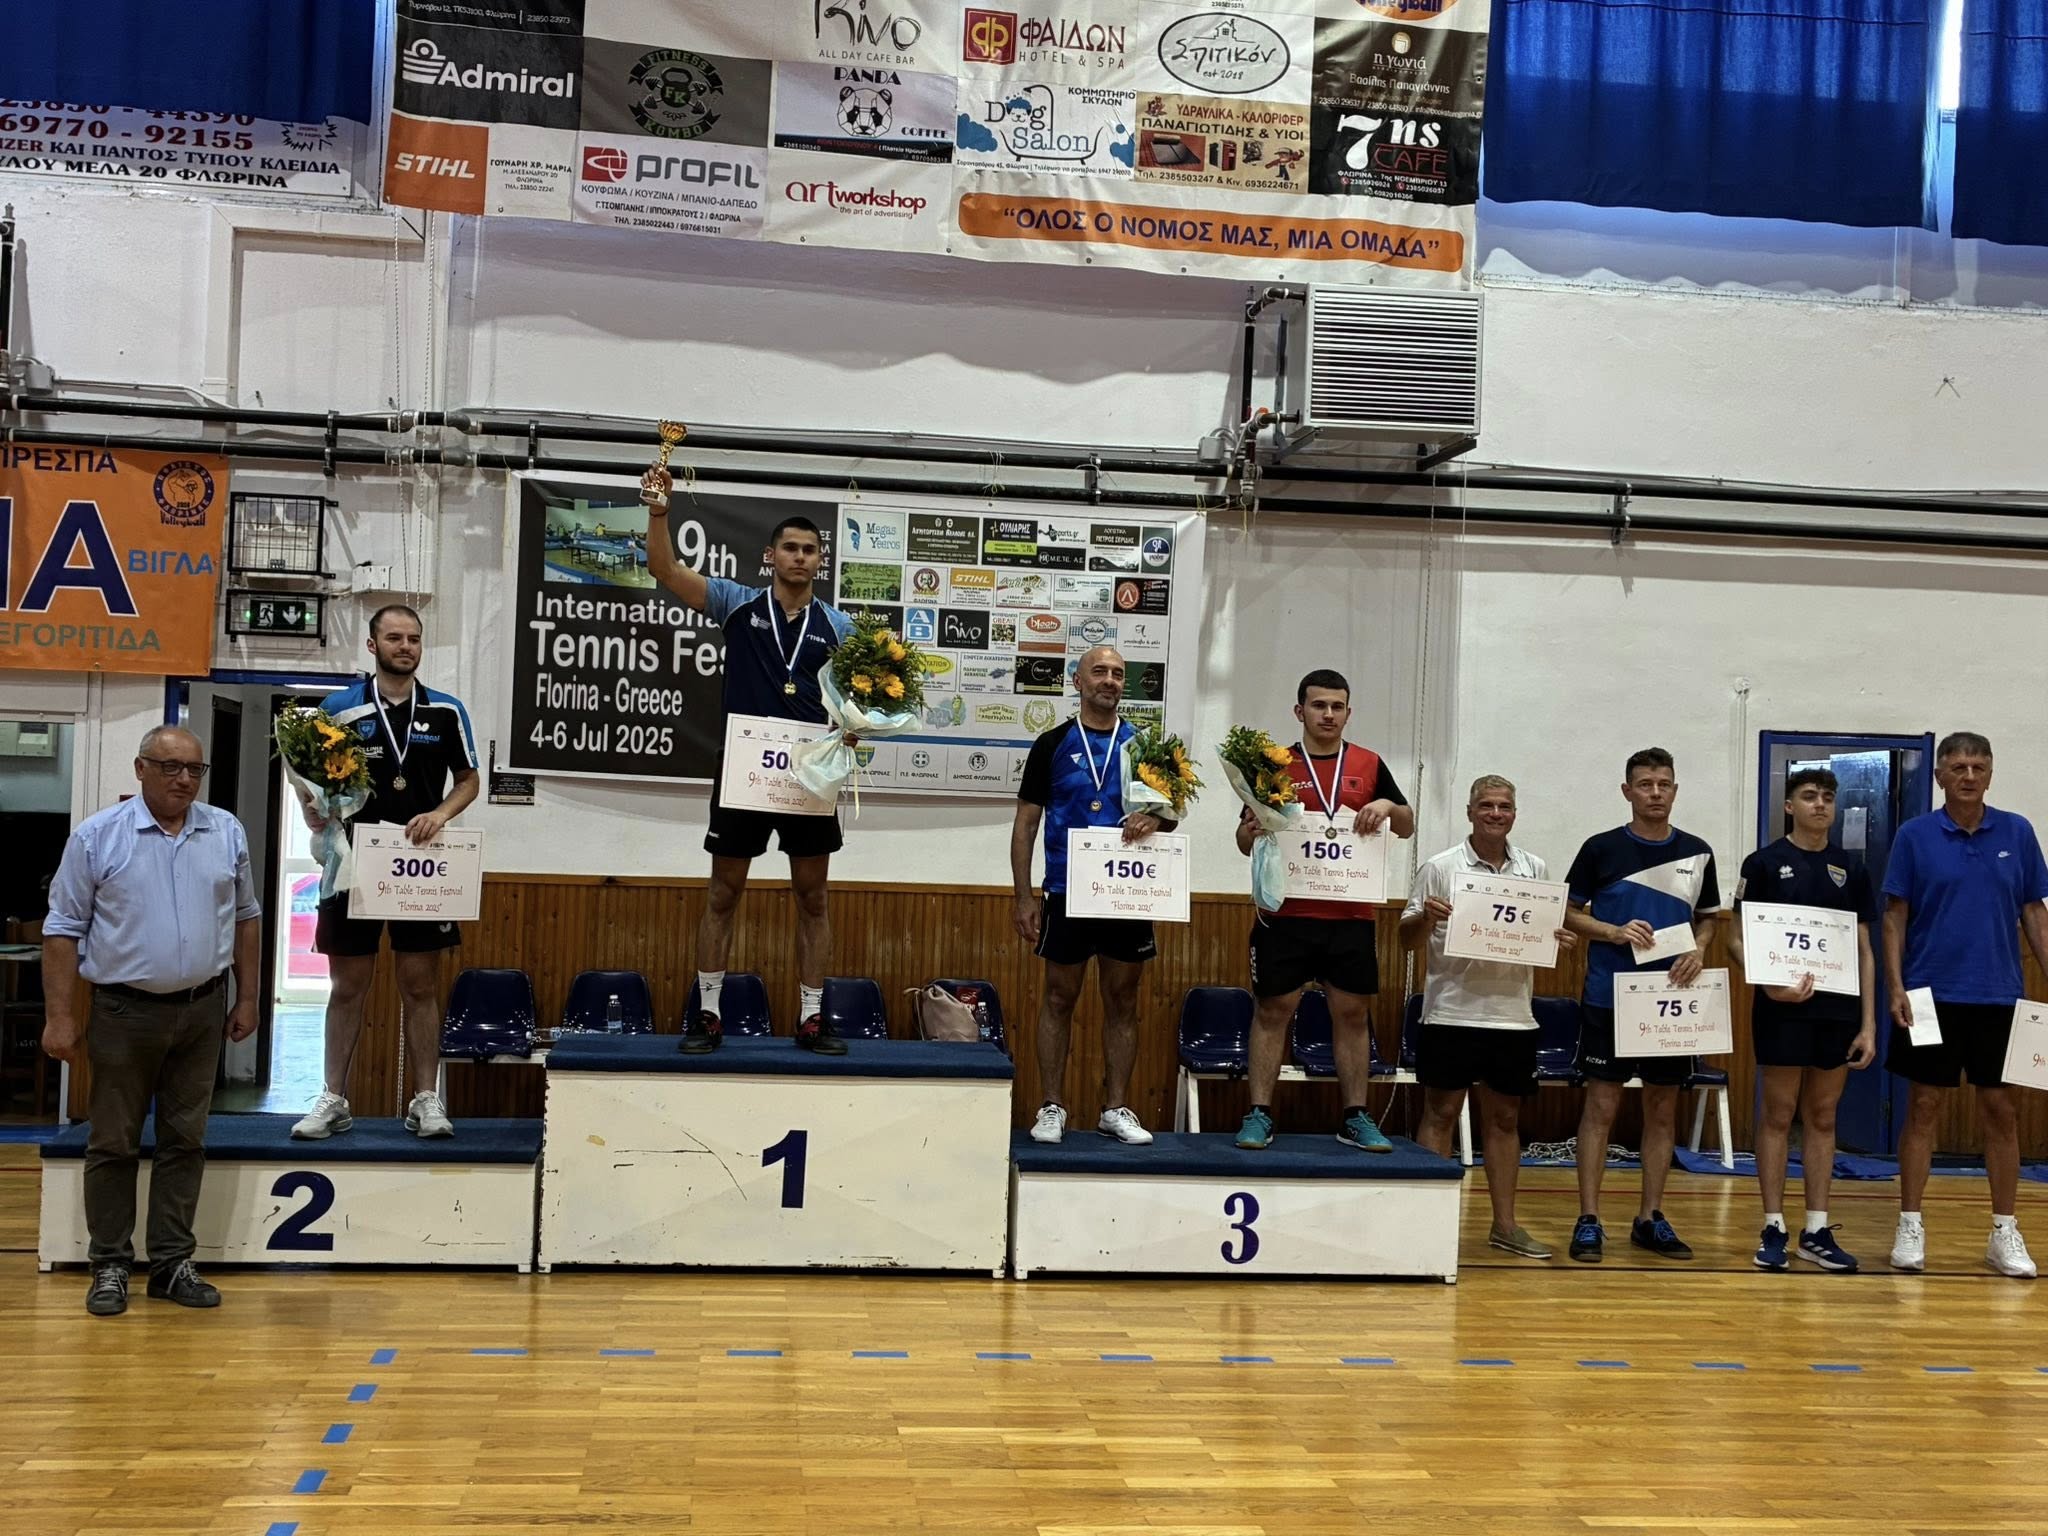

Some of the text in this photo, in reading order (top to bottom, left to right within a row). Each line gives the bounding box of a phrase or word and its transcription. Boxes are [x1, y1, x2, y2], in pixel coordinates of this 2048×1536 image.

[1020, 16, 1125, 53] ΦΑΙΔΩΝ
[648, 50, 709, 70] FITNESS
[819, 50, 915, 64] ALL DAY CAFE BAR
[1019, 51, 1125, 69] HOTEL & SPA
[437, 61, 574, 98] Admiral
[834, 66, 901, 85] PANDA
[1203, 70, 1243, 80] est 2018
[1068, 87, 1136, 100] ΚΟΜΜΩΤΗΡΙΟ
[1082, 96, 1122, 106] ΣΚΥΛΩΝ
[1177, 104, 1304, 126] ΥΔΡΑΥΛΙΚΑ ΚΑΛΟΡΙΦΕΡ
[144, 124, 253, 150] 92155
[1141, 118, 1255, 137] ΠΑΝΑΓΙΩΤΙΔΗΣ
[1259, 129, 1269, 139] &
[1013, 127, 1091, 152] Salon
[50, 142, 84, 155] ΚΑΙ
[92, 145, 177, 161] ΠΑΝΤΟΣ
[185, 152, 253, 167] ΤΥΠΟΥ
[260, 157, 340, 174] ΚΛΕΙΔΙΑ
[394, 152, 476, 179] STIHL
[490, 159, 572, 173] ΓΟΥΝΑΡΗ ΧΡ. ΜΑΡΙΑ
[1373, 148, 1448, 174] CAFE
[65, 161, 130, 176] ΜΕΛΑ
[139, 165, 167, 178] 20
[176, 168, 288, 188] ΦΛΩΡΙΝΑ
[1217, 176, 1224, 184] &
[581, 184, 628, 196] ΚΟΥΦΩΜΑ
[635, 190, 674, 201] ΚΟΥΖΙΝΑ
[709, 212, 741, 222] ΦΛΩΡΙΝΑ
[840, 206, 852, 214] the
[874, 210, 913, 219] advertising
[1095, 211, 1114, 232] Ο
[1121, 216, 1214, 243] ΝΟΜΟΣ
[1220, 225, 1280, 252] ΜΑΣ,
[1288, 227, 1334, 251] ΜΙΑ
[866, 523, 896, 538] Megas
[677, 519, 737, 578] 9th
[128, 550, 214, 575] ΒΙΓΛΑ
[955, 574, 990, 583] STIHL
[945, 615, 982, 640] Rivo
[529, 620, 659, 672] Tennis
[536, 672, 599, 711] Florina
[615, 677, 682, 716] Greece
[530, 719, 673, 756] 4-6 Jul 2025
[1301, 840, 1352, 860] 150€
[392, 858, 448, 878] 300€
[1104, 860, 1157, 879] 150€
[1303, 865, 1320, 876] Table
[1323, 867, 1343, 877] Tennis
[1347, 868, 1369, 878] Festival
[378, 881, 463, 897] 9th Table Tennis Festival
[1092, 881, 1172, 898] 9th Table Tennis Festival
[1493, 904, 1532, 924] 75 €
[1785, 932, 1827, 952] 75 €
[1657, 1000, 1698, 1017] 75 €
[1694, 1022, 1715, 1032] Festival
[763, 1130, 808, 1209] 1
[266, 1170, 334, 1251] 2
[1222, 1191, 1260, 1265] 3
